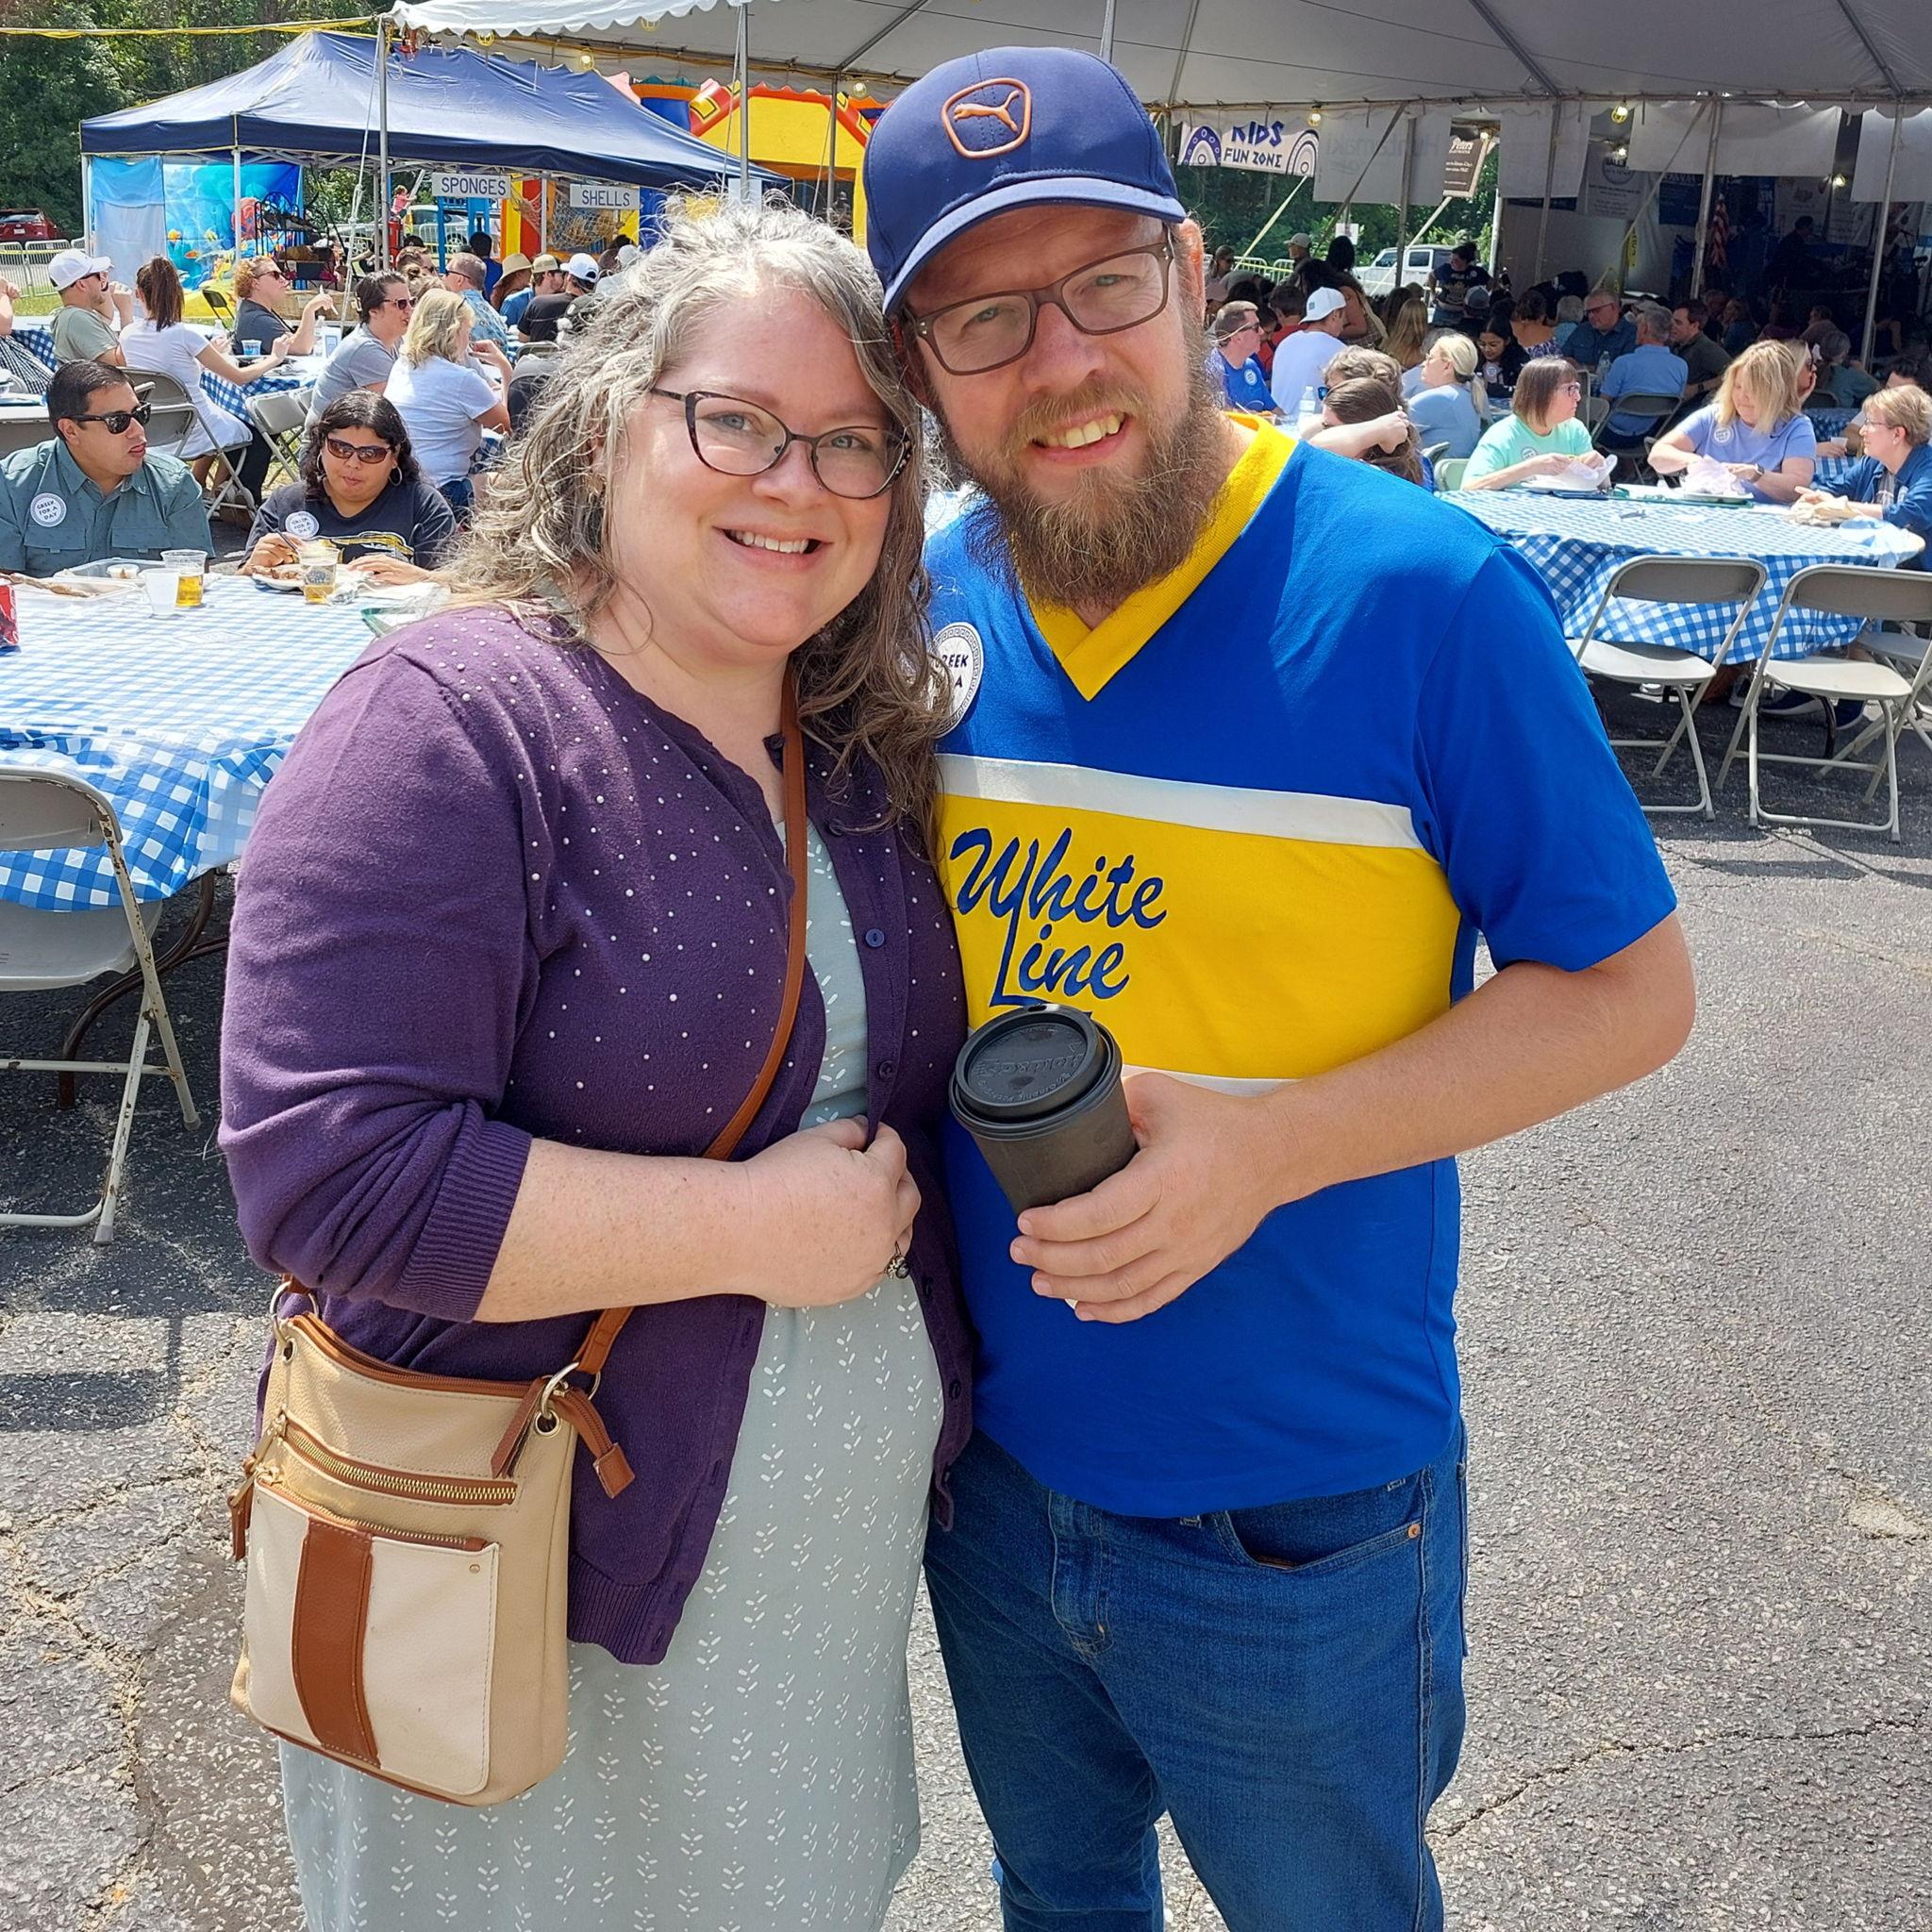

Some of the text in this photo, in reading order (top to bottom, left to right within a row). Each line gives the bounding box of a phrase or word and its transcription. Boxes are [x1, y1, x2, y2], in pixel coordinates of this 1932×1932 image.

[1231, 121, 1285, 147] KIDS
[1224, 147, 1283, 168] FUN ZONE
[441, 176, 507, 196] SPONGES
[581, 190, 630, 207] SHELLS
[941, 654, 969, 668] REEK
[949, 826, 1168, 929] White
[989, 922, 1130, 1008] Line
